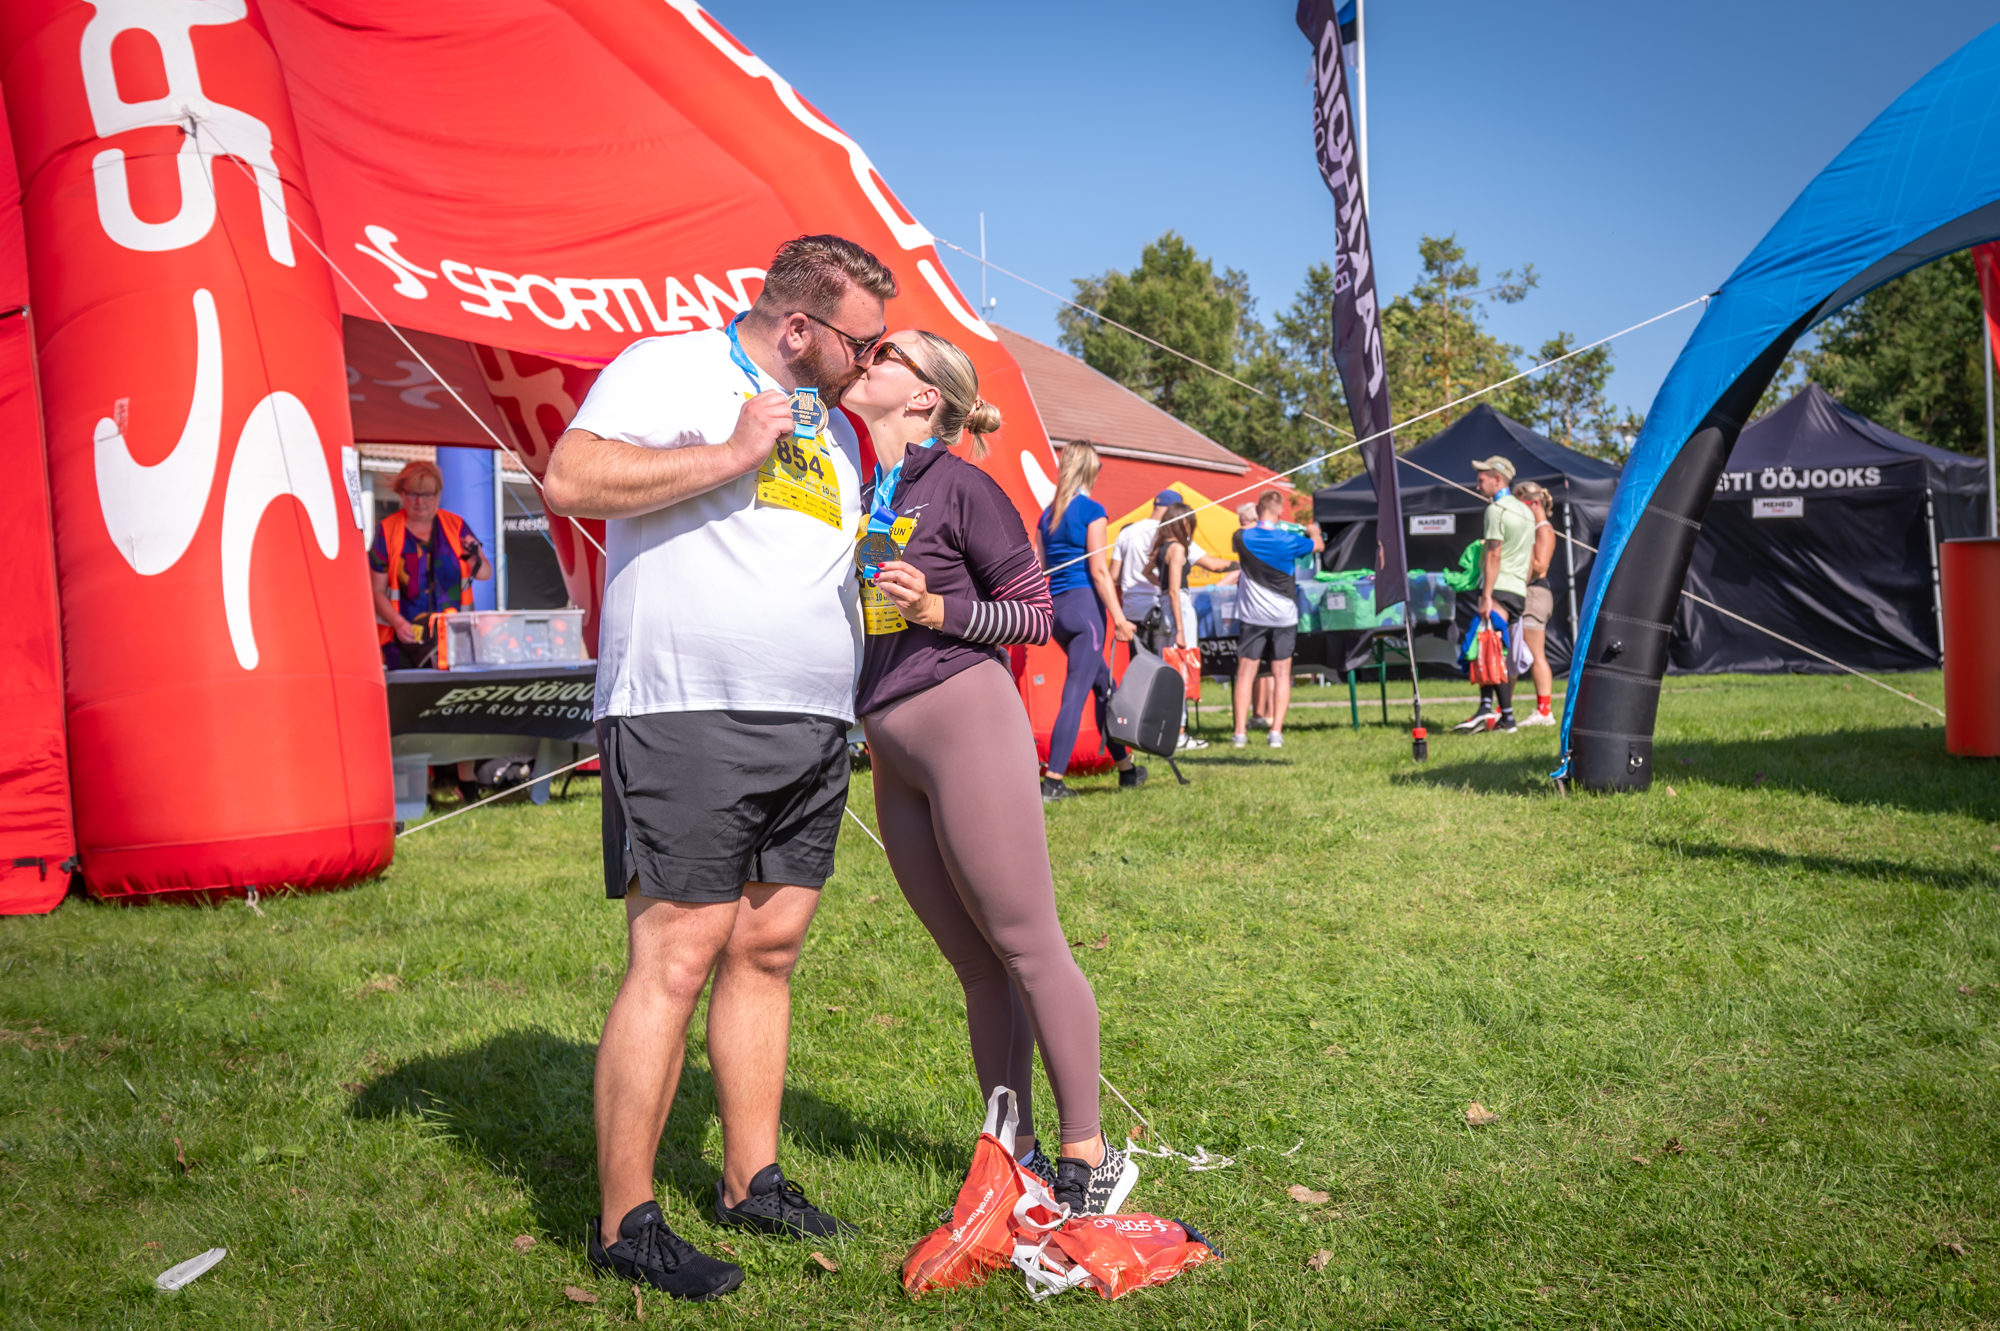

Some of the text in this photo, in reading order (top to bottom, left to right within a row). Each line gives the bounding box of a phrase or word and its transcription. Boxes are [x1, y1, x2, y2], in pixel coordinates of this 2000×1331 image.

[439, 259, 769, 333] SPORTLAND
[775, 438, 825, 480] 854
[1715, 466, 1882, 493] STI ÖÖJOOKS
[1417, 518, 1447, 526] NAISED
[875, 592, 883, 602] 10
[435, 681, 595, 706] EESTI ÖÖJOO
[486, 703, 528, 717] RUN
[533, 704, 594, 721] ESTON
